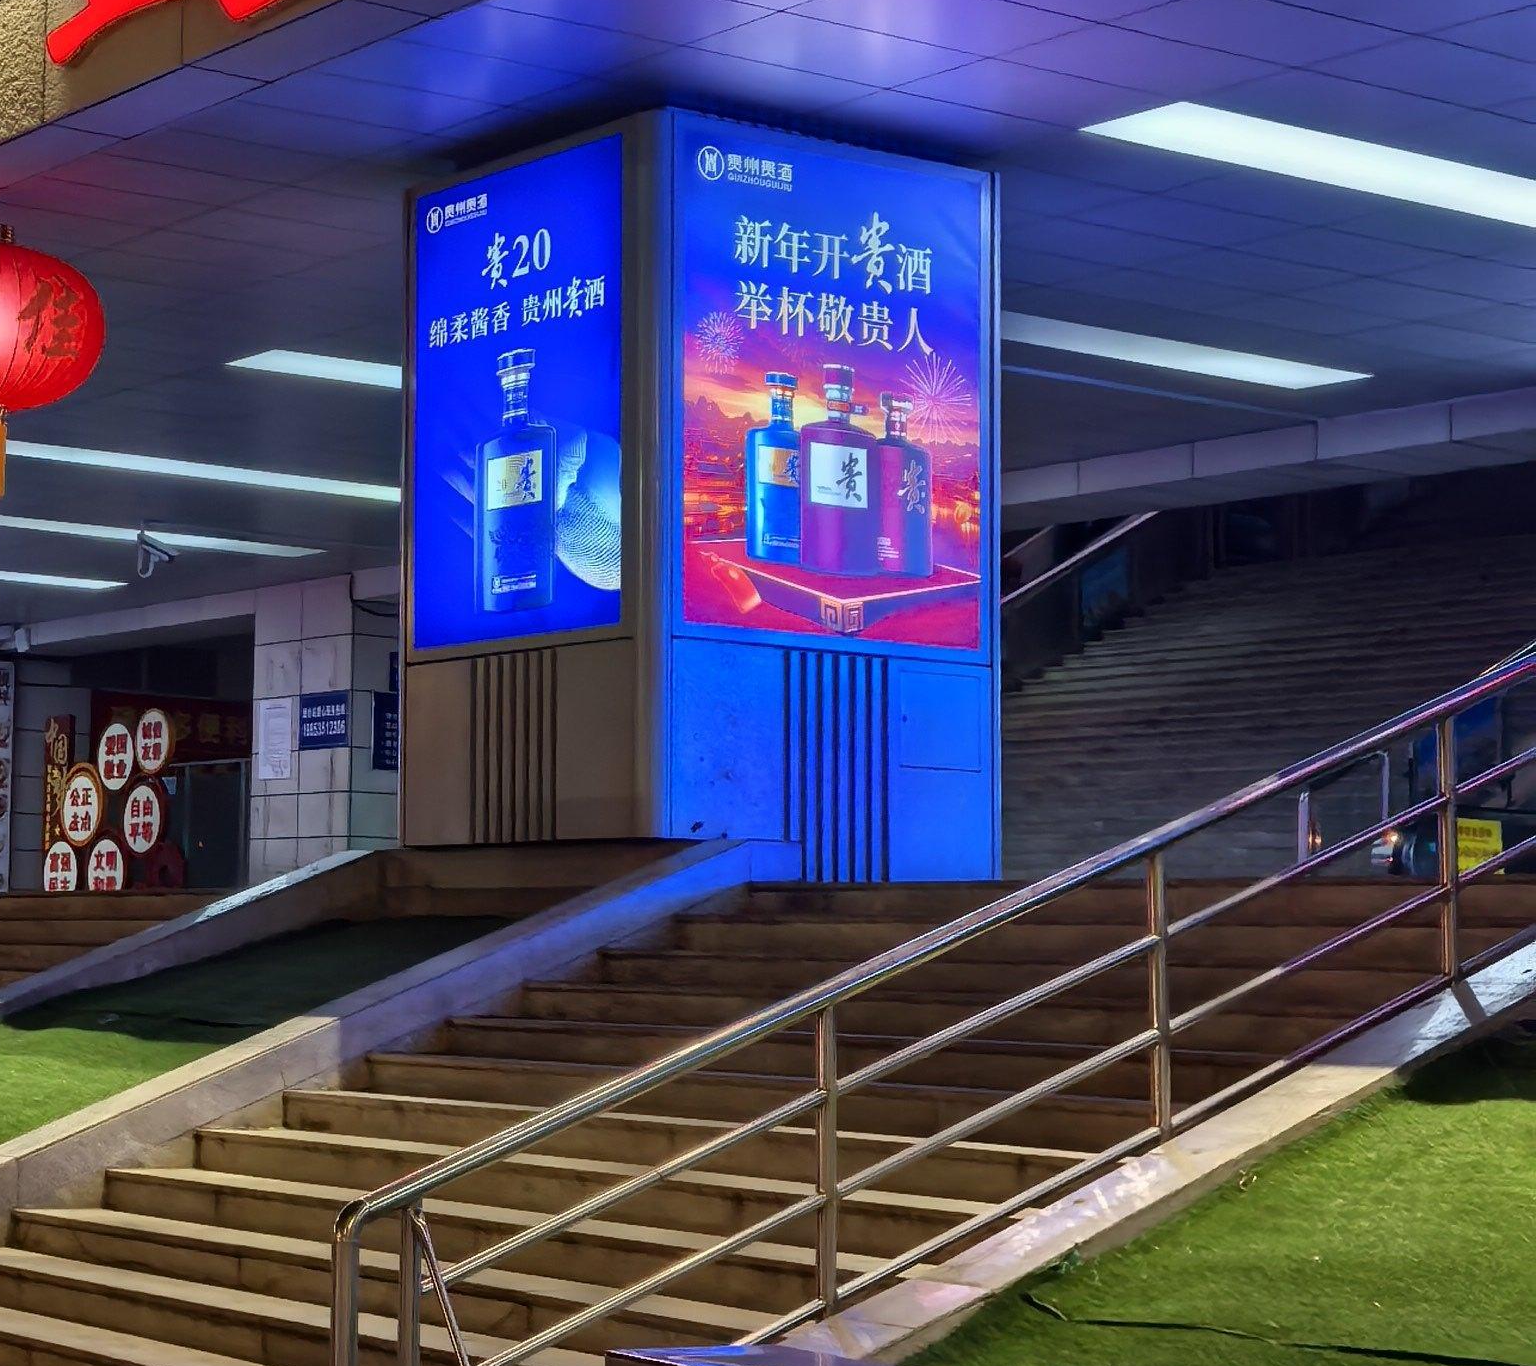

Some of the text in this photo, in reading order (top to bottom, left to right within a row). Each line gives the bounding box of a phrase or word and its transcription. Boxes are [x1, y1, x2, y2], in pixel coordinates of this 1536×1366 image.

[727, 153, 793, 182] 贵州贵酒
[734, 211, 933, 295] 新年开贵酒
[429, 275, 605, 348] 绵柔酱香 贵州贵酒
[734, 280, 934, 355] 举杯敬贵人
[69, 788, 93, 807] 公正
[130, 796, 154, 818] 自由
[94, 850, 118, 872] 文明
